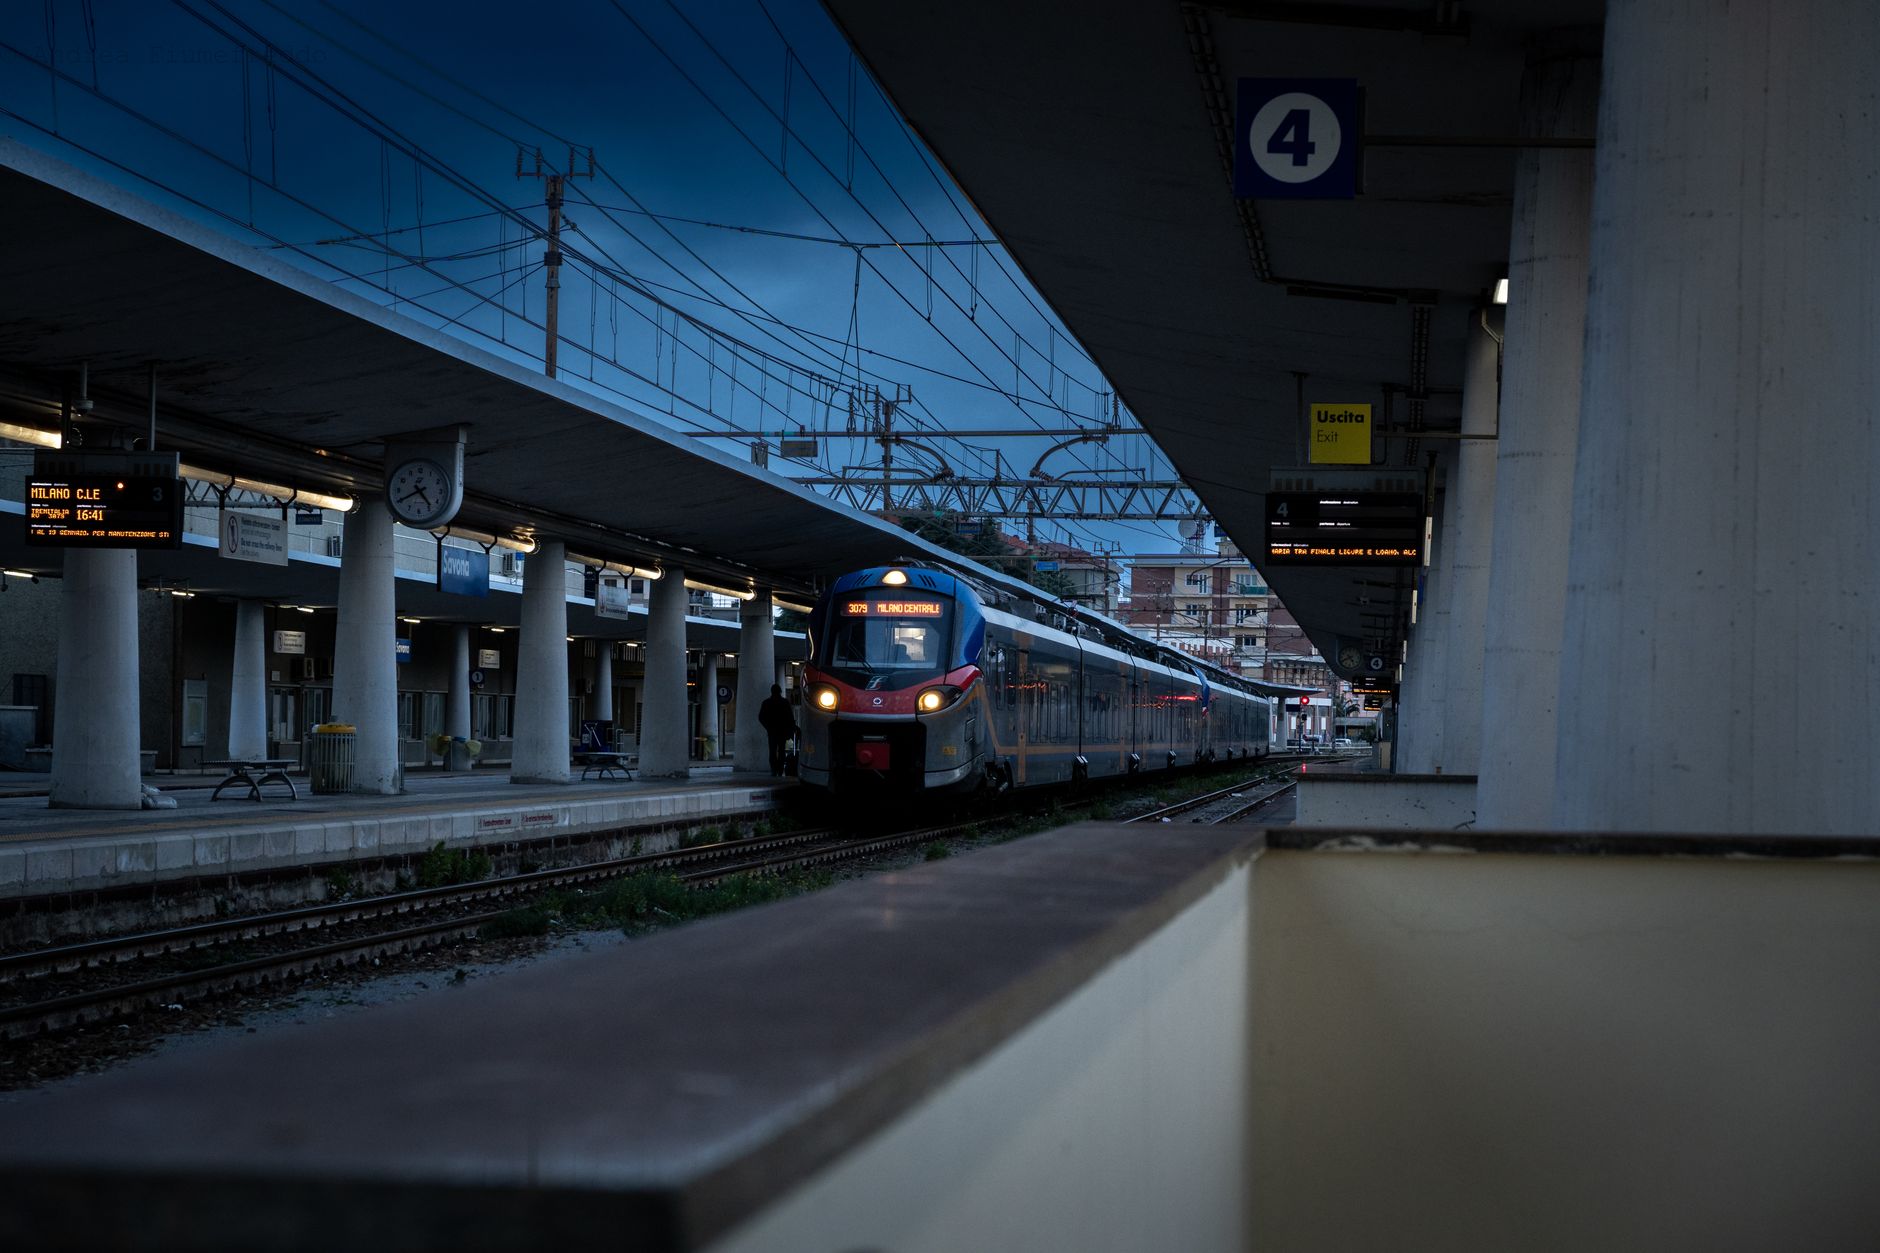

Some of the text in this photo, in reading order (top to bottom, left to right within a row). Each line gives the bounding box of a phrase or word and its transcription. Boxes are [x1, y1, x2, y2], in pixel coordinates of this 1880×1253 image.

[1267, 109, 1316, 166] 4
[1317, 410, 1365, 423] Uscita
[1317, 429, 1339, 443] Exit
[31, 487, 101, 500] MILANO C.LE
[152, 487, 164, 502] 3
[76, 510, 104, 521] 16:41
[1276, 502, 1289, 518] 4
[443, 550, 470, 577] Savona
[848, 603, 940, 614] 3079 MILANO CENTRALE
[1373, 659, 1380, 668] 4
